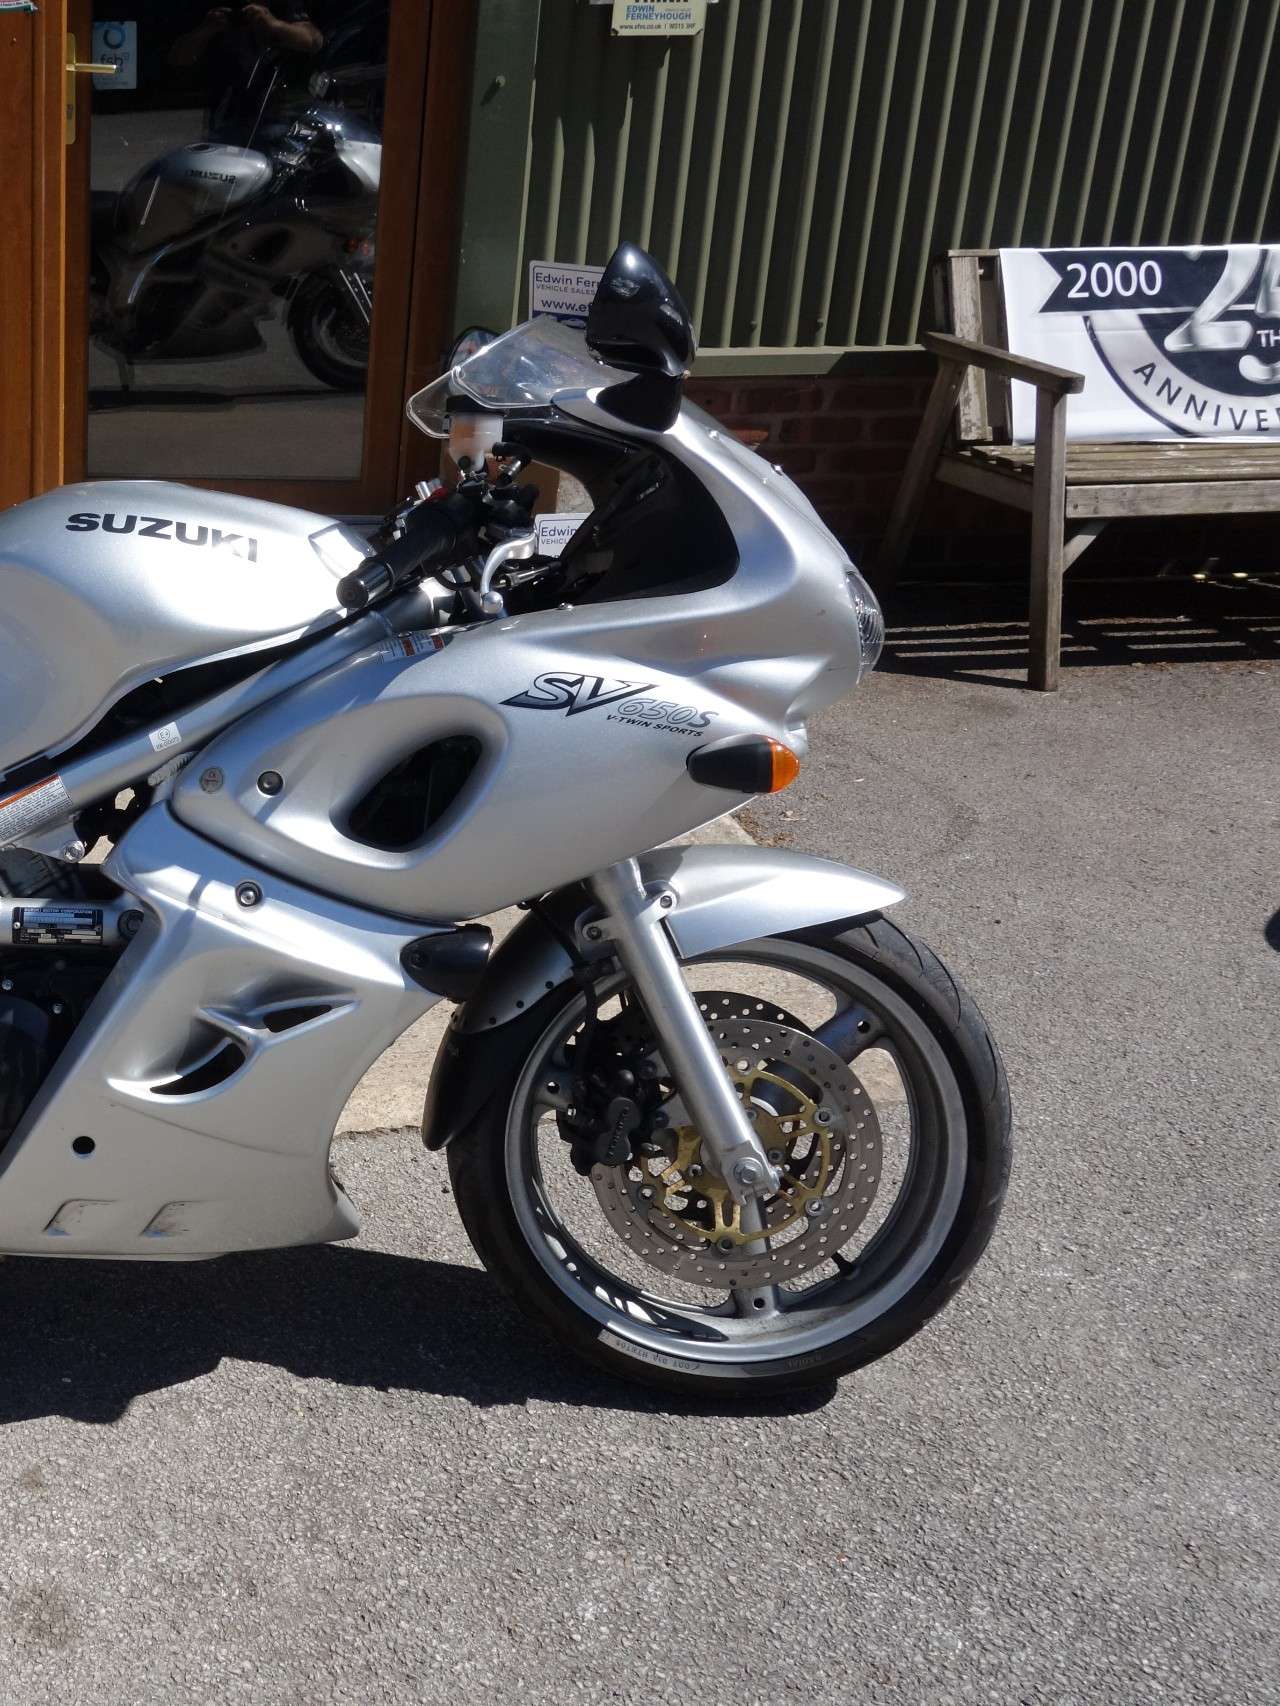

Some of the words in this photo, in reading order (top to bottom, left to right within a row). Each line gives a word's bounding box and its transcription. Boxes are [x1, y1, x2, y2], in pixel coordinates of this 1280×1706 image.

[625, 12, 692, 21] FERNEYHOUGH
[535, 272, 573, 286] Edwin
[536, 283, 569, 294] VEHICLE
[571, 287, 596, 297] SALES
[1066, 260, 1163, 300] 2000
[1132, 361, 1280, 434] ANNIVE
[65, 512, 258, 564] SUZUKI
[498, 671, 660, 717] SV
[606, 714, 652, 728] V-TWIN
[652, 721, 705, 737] SPORTS
[617, 698, 719, 729] 650S
